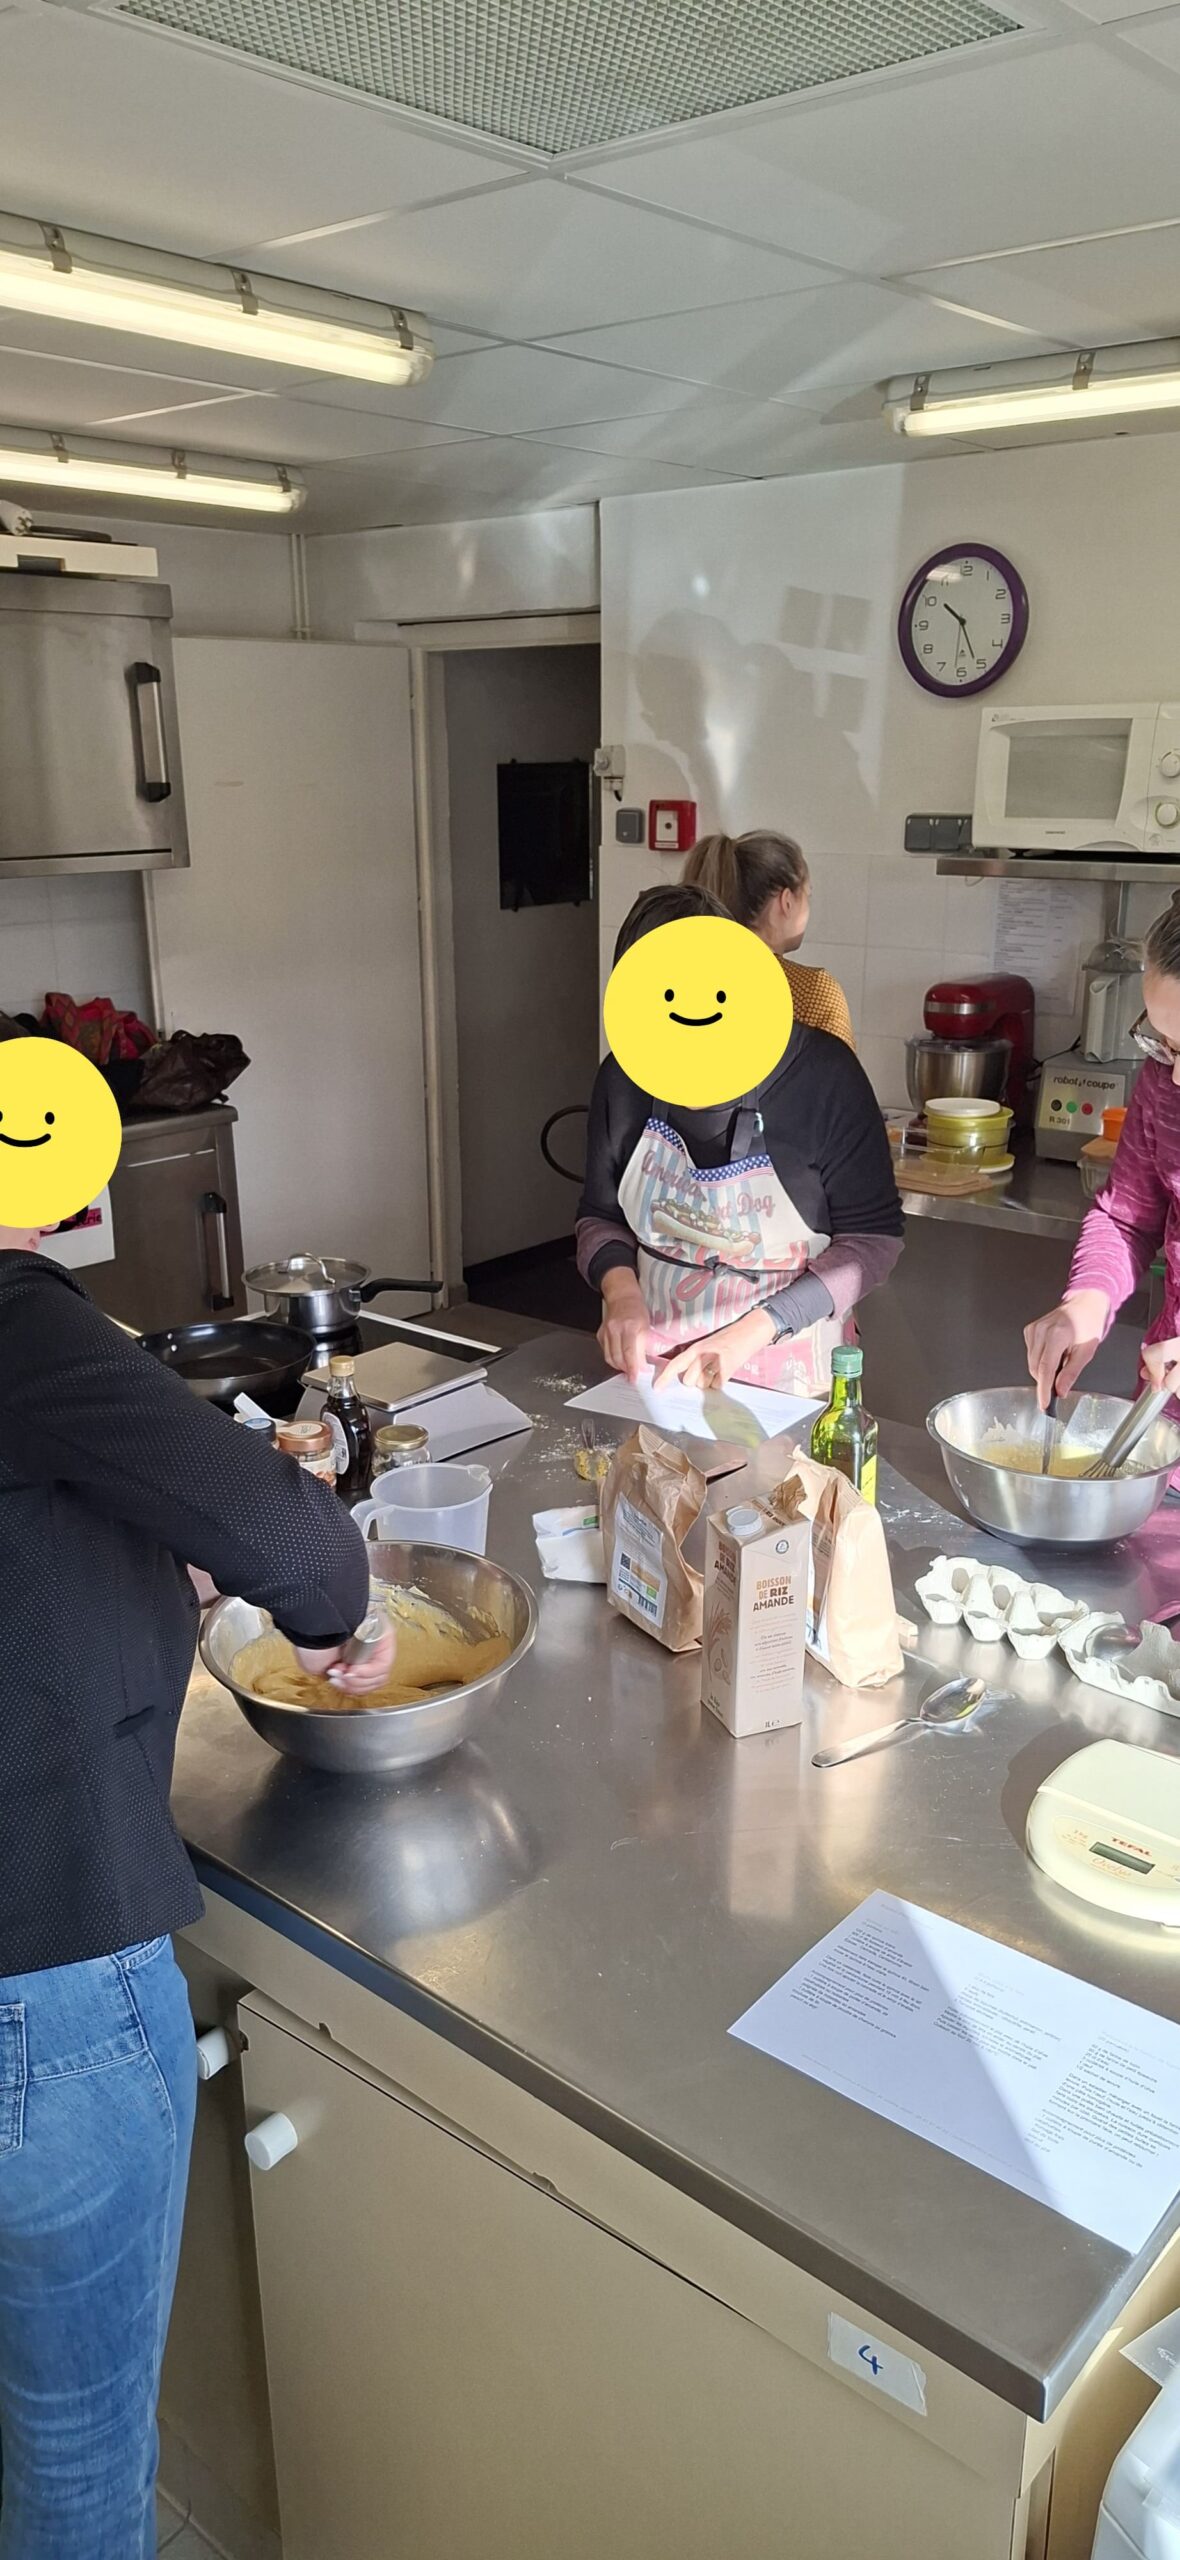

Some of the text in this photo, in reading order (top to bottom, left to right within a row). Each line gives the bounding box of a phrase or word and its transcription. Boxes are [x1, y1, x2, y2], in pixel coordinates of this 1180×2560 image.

[995, 588, 1007, 600] 2
[924, 595, 938, 608] 10
[1001, 613, 1011, 625] 3
[918, 620, 929, 631] 9
[923, 643, 934, 654] 8
[991, 639, 1003, 649] 4
[936, 661, 947, 672] 7
[975, 659, 987, 670] 5
[956, 667, 967, 678] 6
[1086, 1080, 1117, 1091] coupe
[736, 1191, 775, 1218] Dog
[756, 1575, 792, 1591] BOISSON
[758, 1586, 789, 1600] DE RIZ
[752, 1595, 795, 1612] AMANDE
[1111, 1836, 1152, 1857] TEFAL
[857, 2343, 884, 2376] 4
